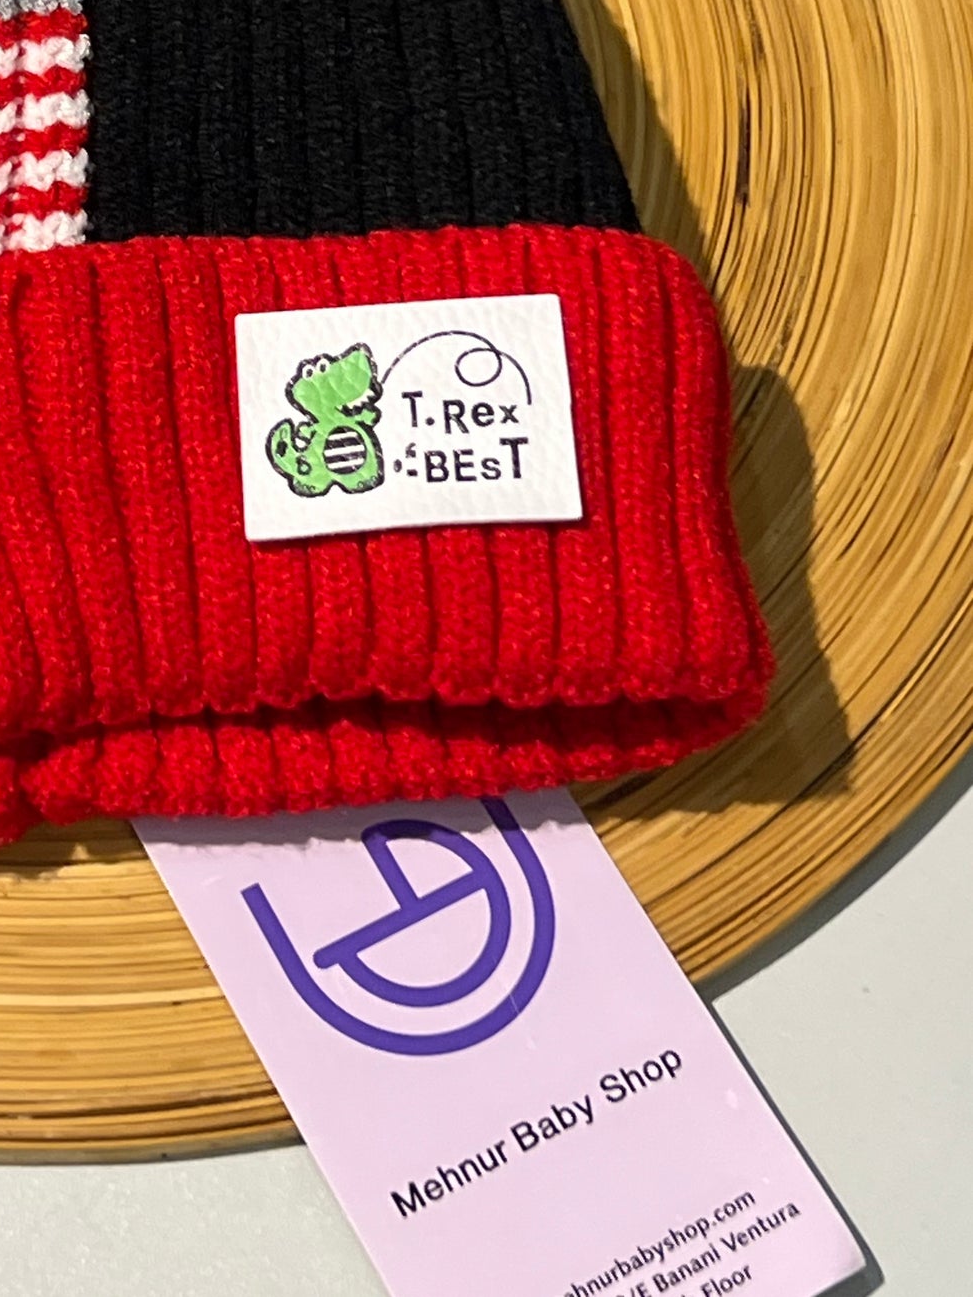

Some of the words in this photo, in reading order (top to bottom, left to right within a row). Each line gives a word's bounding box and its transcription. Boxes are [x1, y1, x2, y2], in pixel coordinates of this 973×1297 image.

[390, 1140, 509, 1218] Mehnur
[510, 1094, 594, 1152] Baby
[599, 1048, 683, 1104] Shop
[651, 1246, 722, 1294] Banani
[721, 1202, 801, 1253] Ventura
[700, 1264, 752, 1297] Floor
